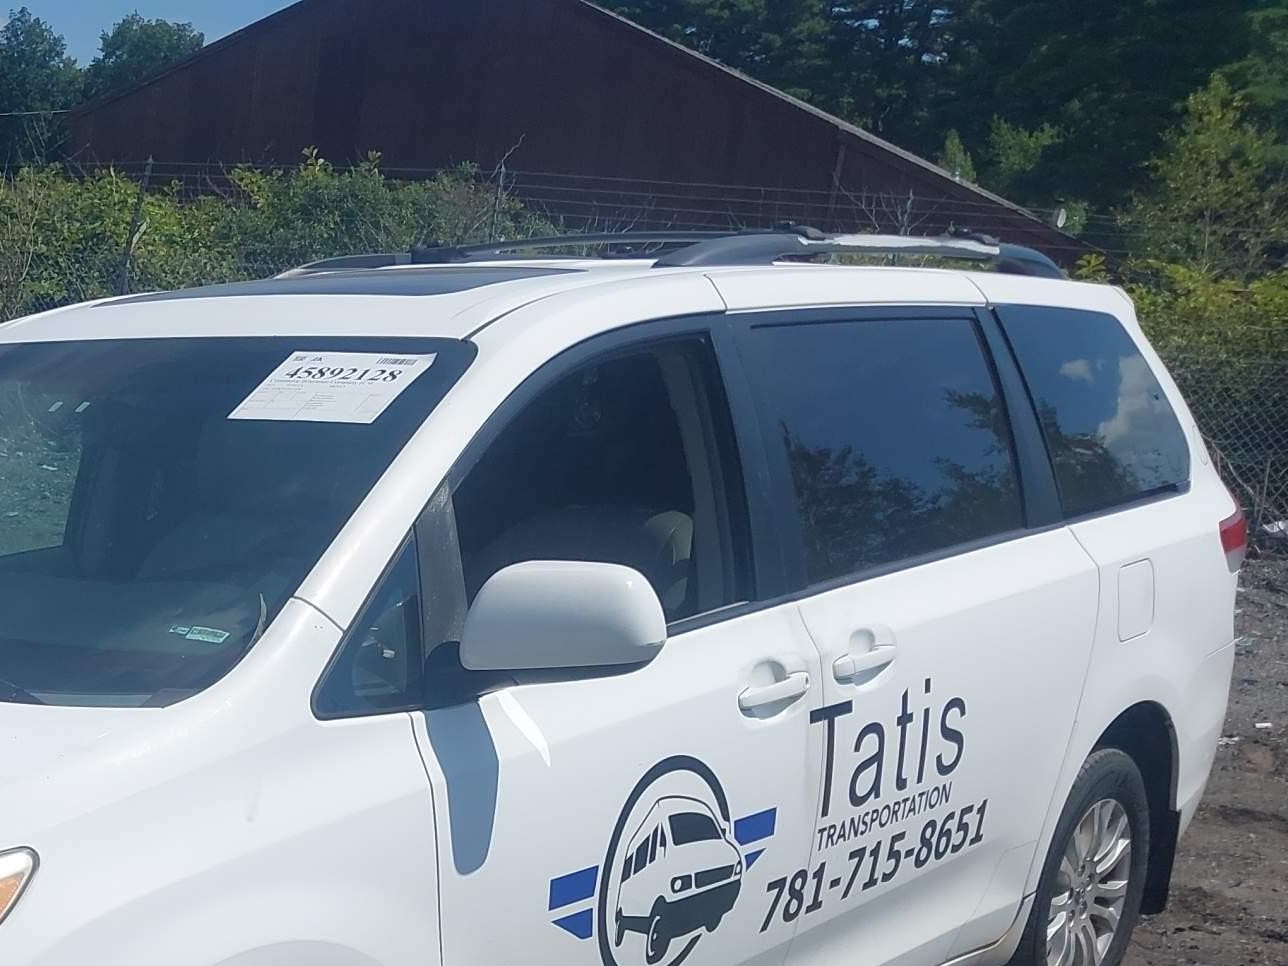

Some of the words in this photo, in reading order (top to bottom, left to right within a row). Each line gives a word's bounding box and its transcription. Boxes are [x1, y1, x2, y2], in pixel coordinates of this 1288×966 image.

[285, 366, 403, 382] 45892128
[808, 677, 967, 818] Tatis
[758, 799, 989, 934] 781-715-8651
[816, 780, 953, 852] TRANSPORTATION
